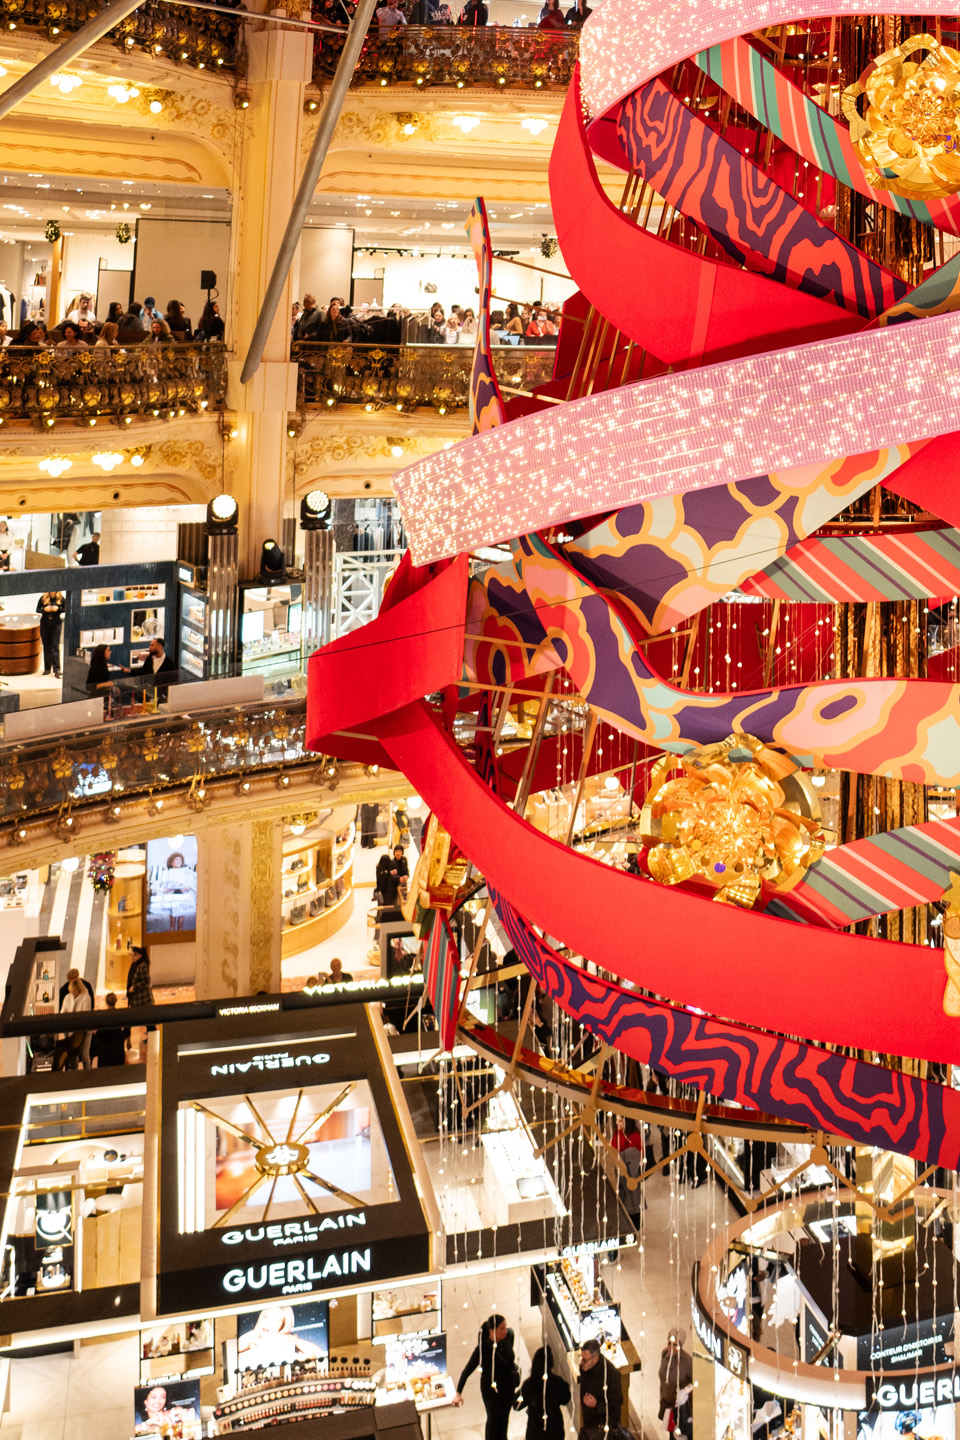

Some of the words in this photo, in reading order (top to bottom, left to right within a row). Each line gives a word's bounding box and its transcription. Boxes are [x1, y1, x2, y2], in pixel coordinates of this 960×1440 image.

[303, 978, 389, 996] VICTORIA
[219, 1006, 249, 1016] VICTORIA
[210, 1054, 331, 1076] GUERLAIN
[221, 1212, 367, 1245] GUERLAIN
[273, 1233, 318, 1247] PARIS
[562, 1237, 620, 1257] GUERLAIN
[222, 1248, 371, 1293] GUERLAIN
[281, 1281, 313, 1295] PARIS
[869, 1345, 903, 1361] CONTEUR
[890, 1348, 924, 1364] SHALIMAR
